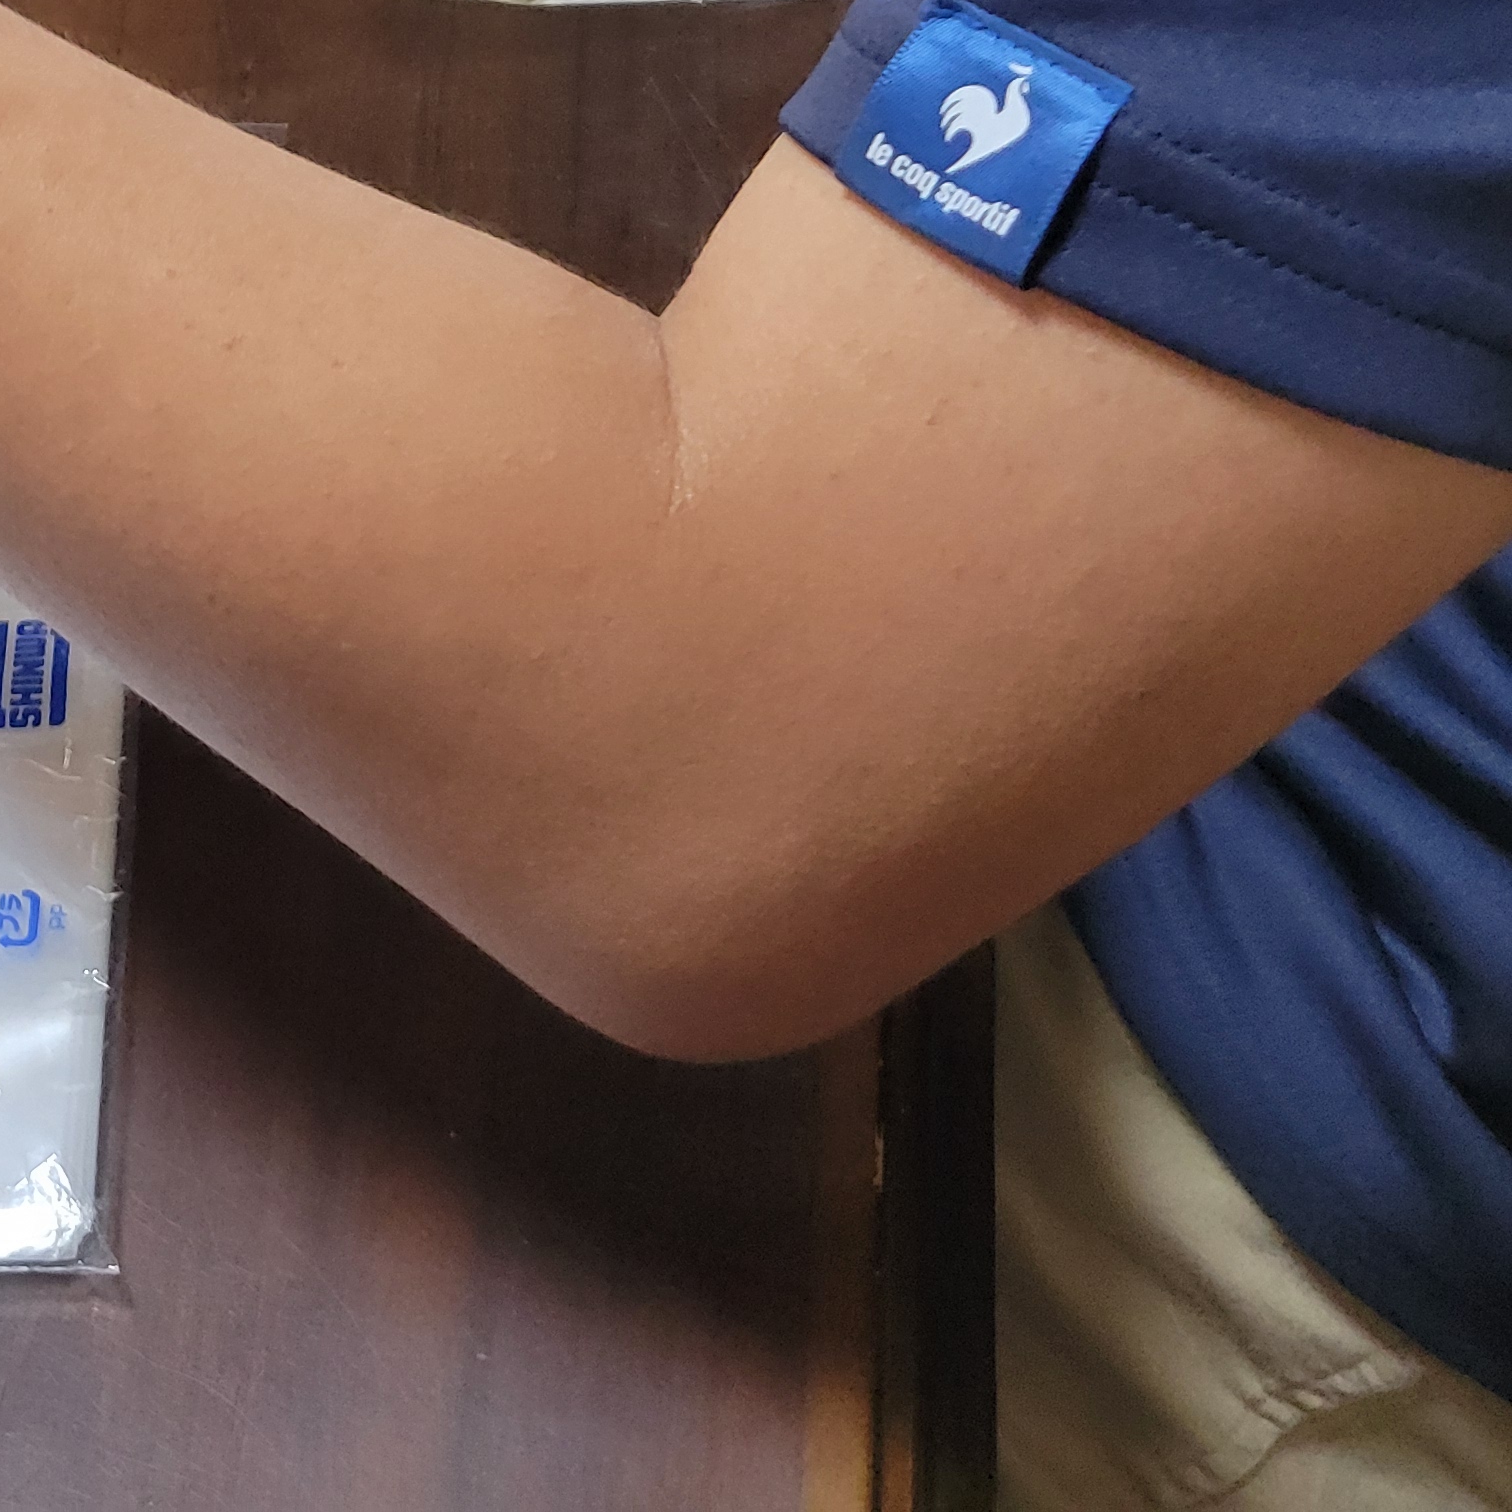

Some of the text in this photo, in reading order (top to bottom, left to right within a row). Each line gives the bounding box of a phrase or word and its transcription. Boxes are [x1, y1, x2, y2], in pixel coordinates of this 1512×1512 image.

[864, 131, 1023, 238] le coq sportif
